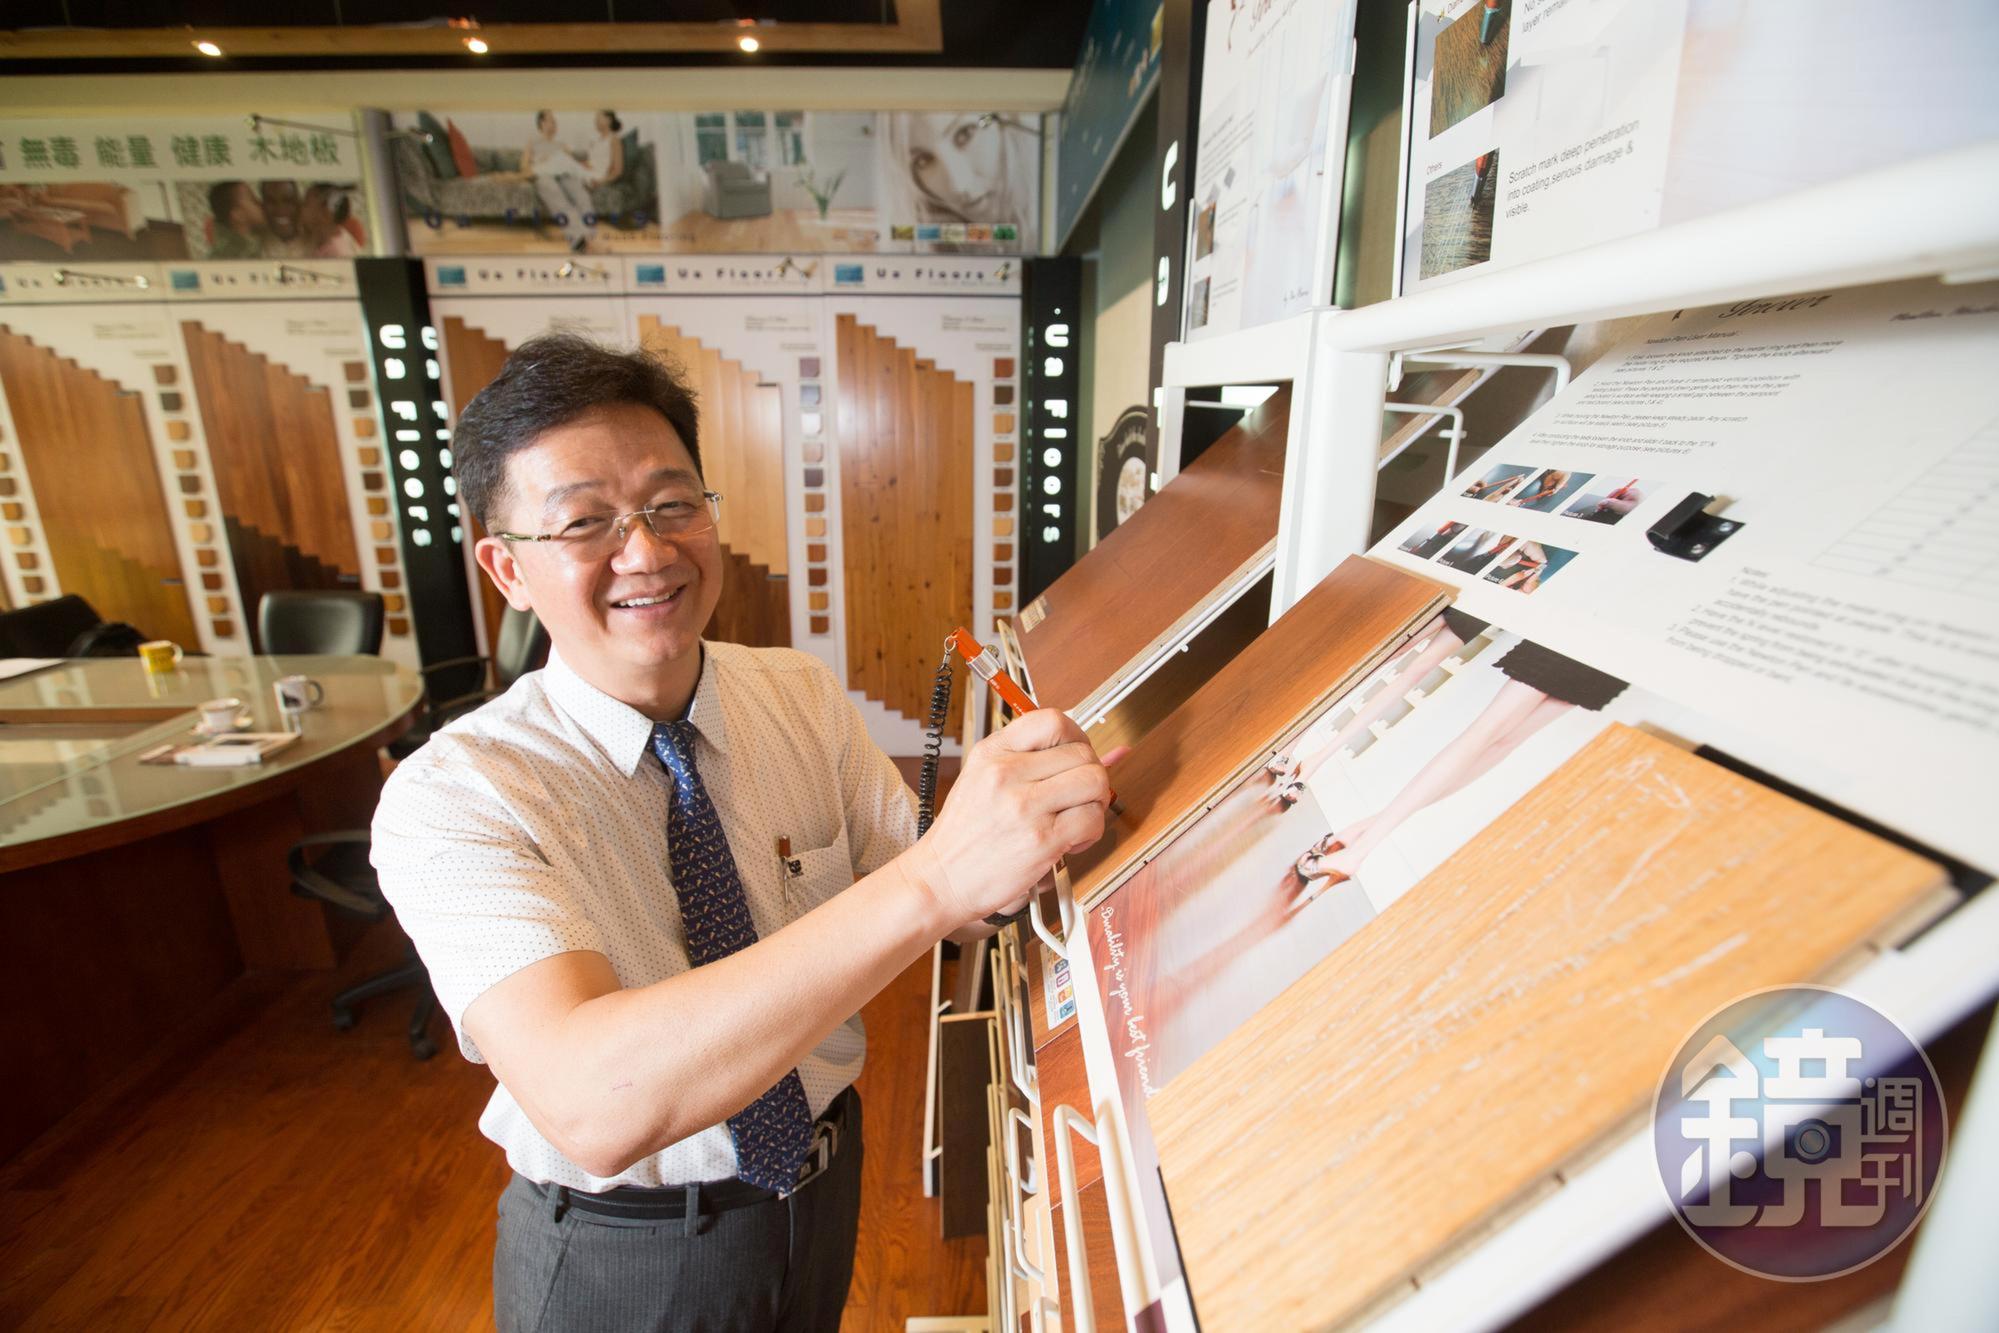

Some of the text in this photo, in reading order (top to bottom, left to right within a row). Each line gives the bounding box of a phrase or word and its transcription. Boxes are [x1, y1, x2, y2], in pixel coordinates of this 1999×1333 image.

[172, 134, 232, 167] 健康
[248, 132, 341, 166] 木地板
[1508, 119, 1640, 184] Scratch mark deep penetration
[1584, 147, 1624, 172] damage
[379, 323, 432, 547] Ua Floors
[1042, 323, 1070, 544] Ua Floors
[1108, 978, 1134, 1016] your
[1126, 1014, 1146, 1044] best
[1124, 1042, 1161, 1099] friend
